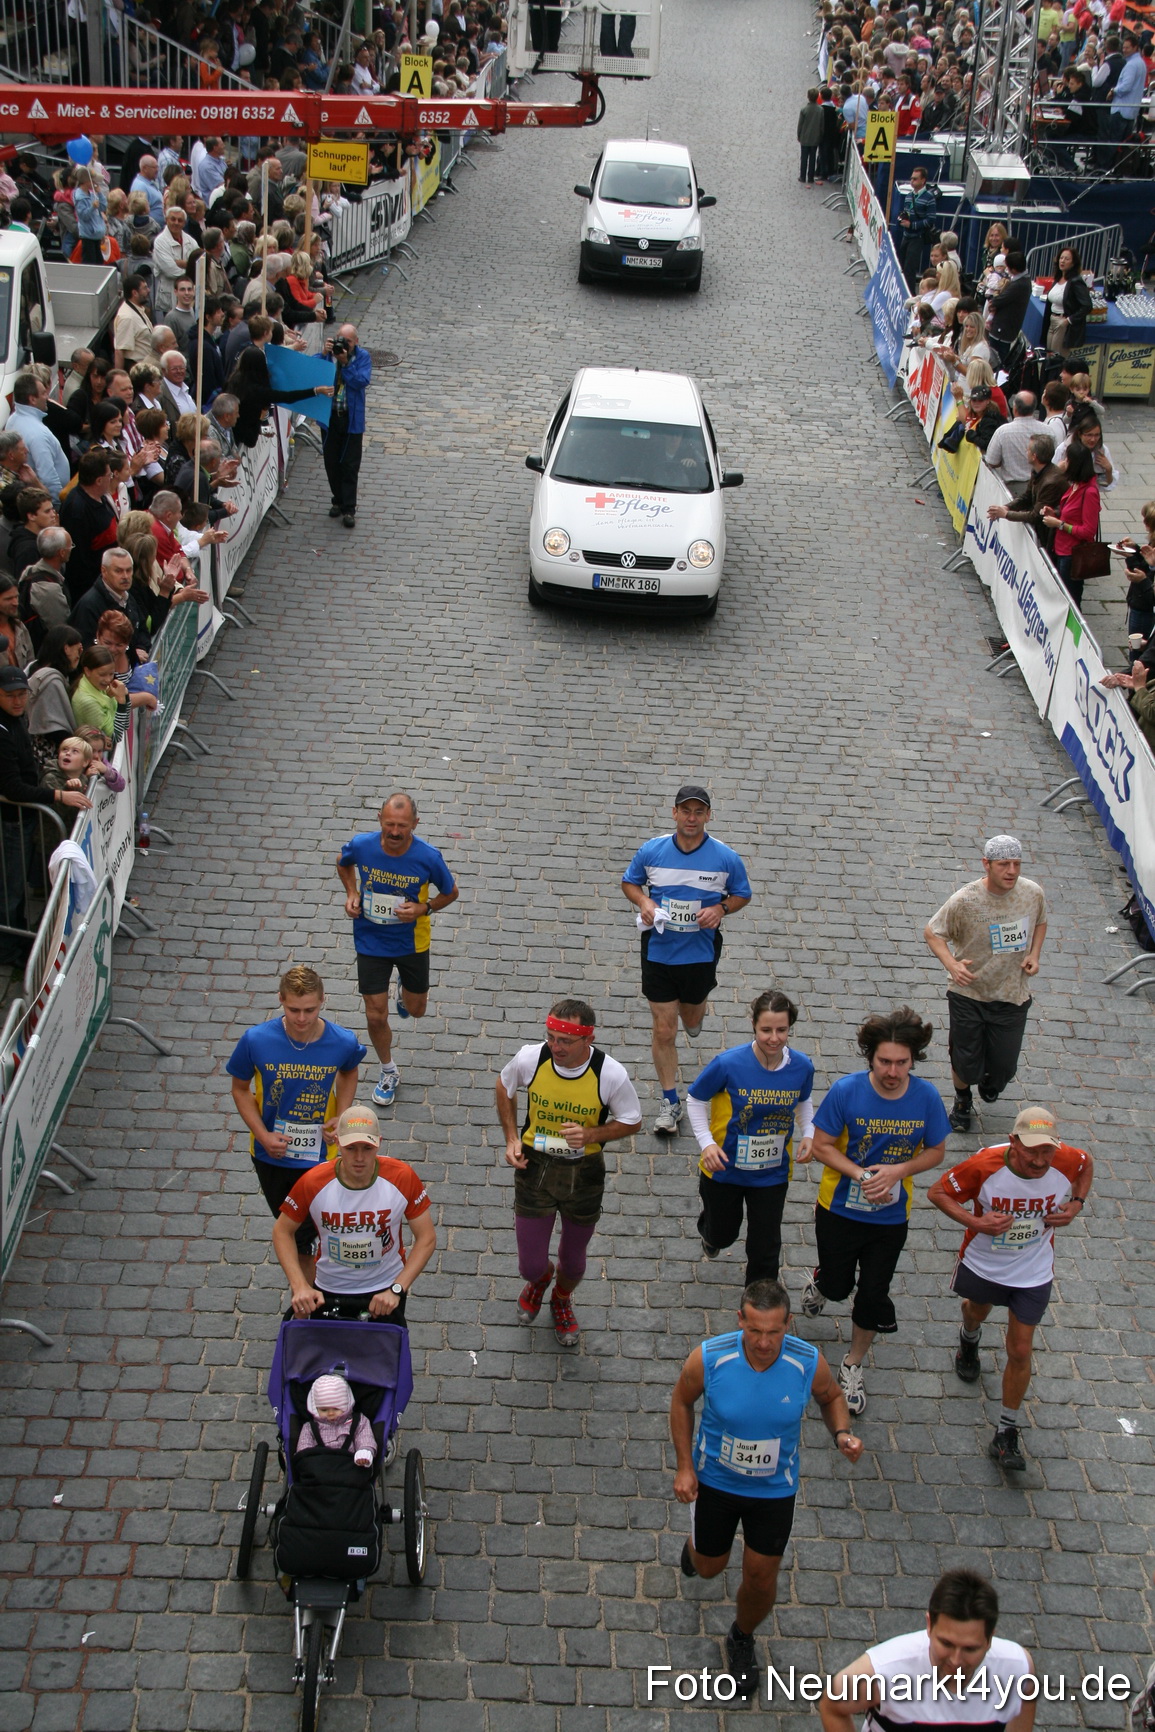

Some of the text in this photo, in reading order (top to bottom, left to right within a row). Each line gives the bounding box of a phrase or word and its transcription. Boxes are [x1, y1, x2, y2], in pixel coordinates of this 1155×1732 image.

[404, 56, 429, 67] Block
[407, 70, 424, 95] A
[57, 103, 275, 120] Miet- & Serviceline: 09181 6352
[419, 111, 450, 124] 6352
[871, 113, 896, 123] Block
[871, 127, 889, 151] A
[312, 148, 365, 162] Schnupper-
[329, 162, 347, 172] lauf
[649, 259, 662, 267] 152
[1131, 360, 1152, 369] Bier
[609, 493, 668, 503] AMBULANTE
[613, 499, 674, 518] Pflege
[600, 576, 658, 591] NM RK 186
[1075, 657, 1135, 804] BOCK
[369, 874, 410, 889] STADTLAUF
[371, 868, 420, 884] NEUMARKTER
[671, 902, 690, 910] Eduard
[671, 912, 697, 922] 2100
[1001, 924, 1018, 932] Daniel
[1003, 930, 1027, 943] 2841
[265, 1063, 337, 1074] 10. NEUMARKTER
[276, 1071, 326, 1081] STADTLAUF
[738, 1088, 749, 1097] 10.
[531, 1091, 597, 1116] Die wilden
[747, 1096, 795, 1106] STADTLAUF
[856, 1117, 925, 1128] 10. NEUMARKTER
[287, 1125, 318, 1135] Sebastian
[866, 1126, 914, 1136] STADTLAUF
[750, 1147, 779, 1158] 3613
[991, 1194, 1056, 1213] MERZ
[321, 1209, 392, 1227] MERZ
[322, 1218, 376, 1234] Reisen
[1008, 1229, 1039, 1241] 2869
[342, 1241, 372, 1249] Reinhard
[343, 1250, 374, 1259] 2881
[735, 1452, 772, 1464] 3410
